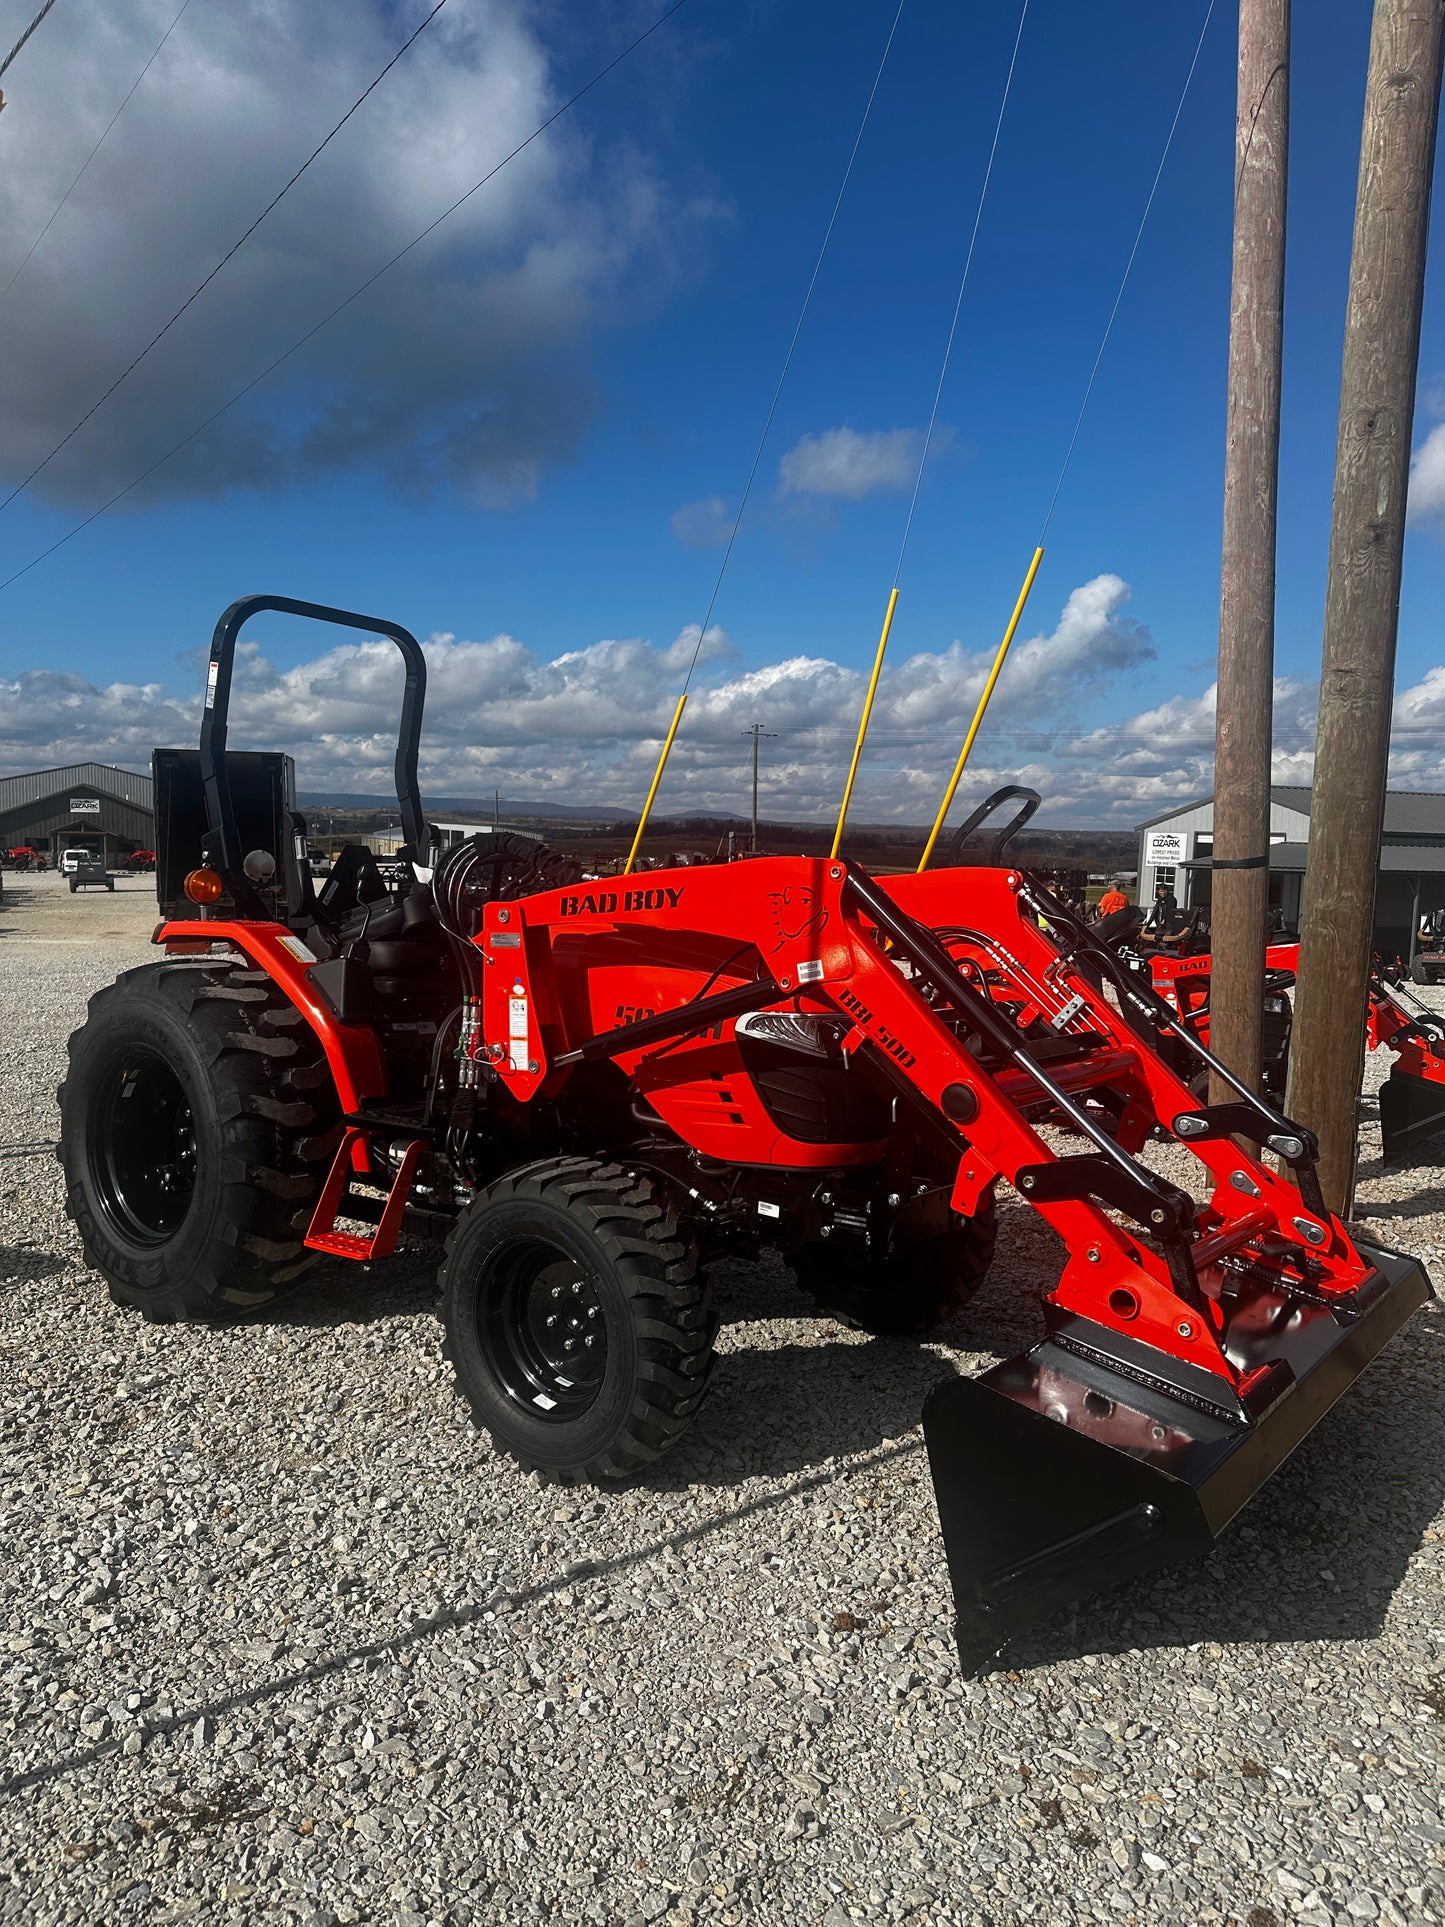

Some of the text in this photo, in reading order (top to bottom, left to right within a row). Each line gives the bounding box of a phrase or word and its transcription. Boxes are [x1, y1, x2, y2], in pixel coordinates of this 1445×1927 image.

[1153, 839, 1180, 847] OZARK
[560, 887, 685, 916] BAD BOY
[1179, 960, 1208, 972] BAD
[838, 988, 917, 1069] BBL 500
